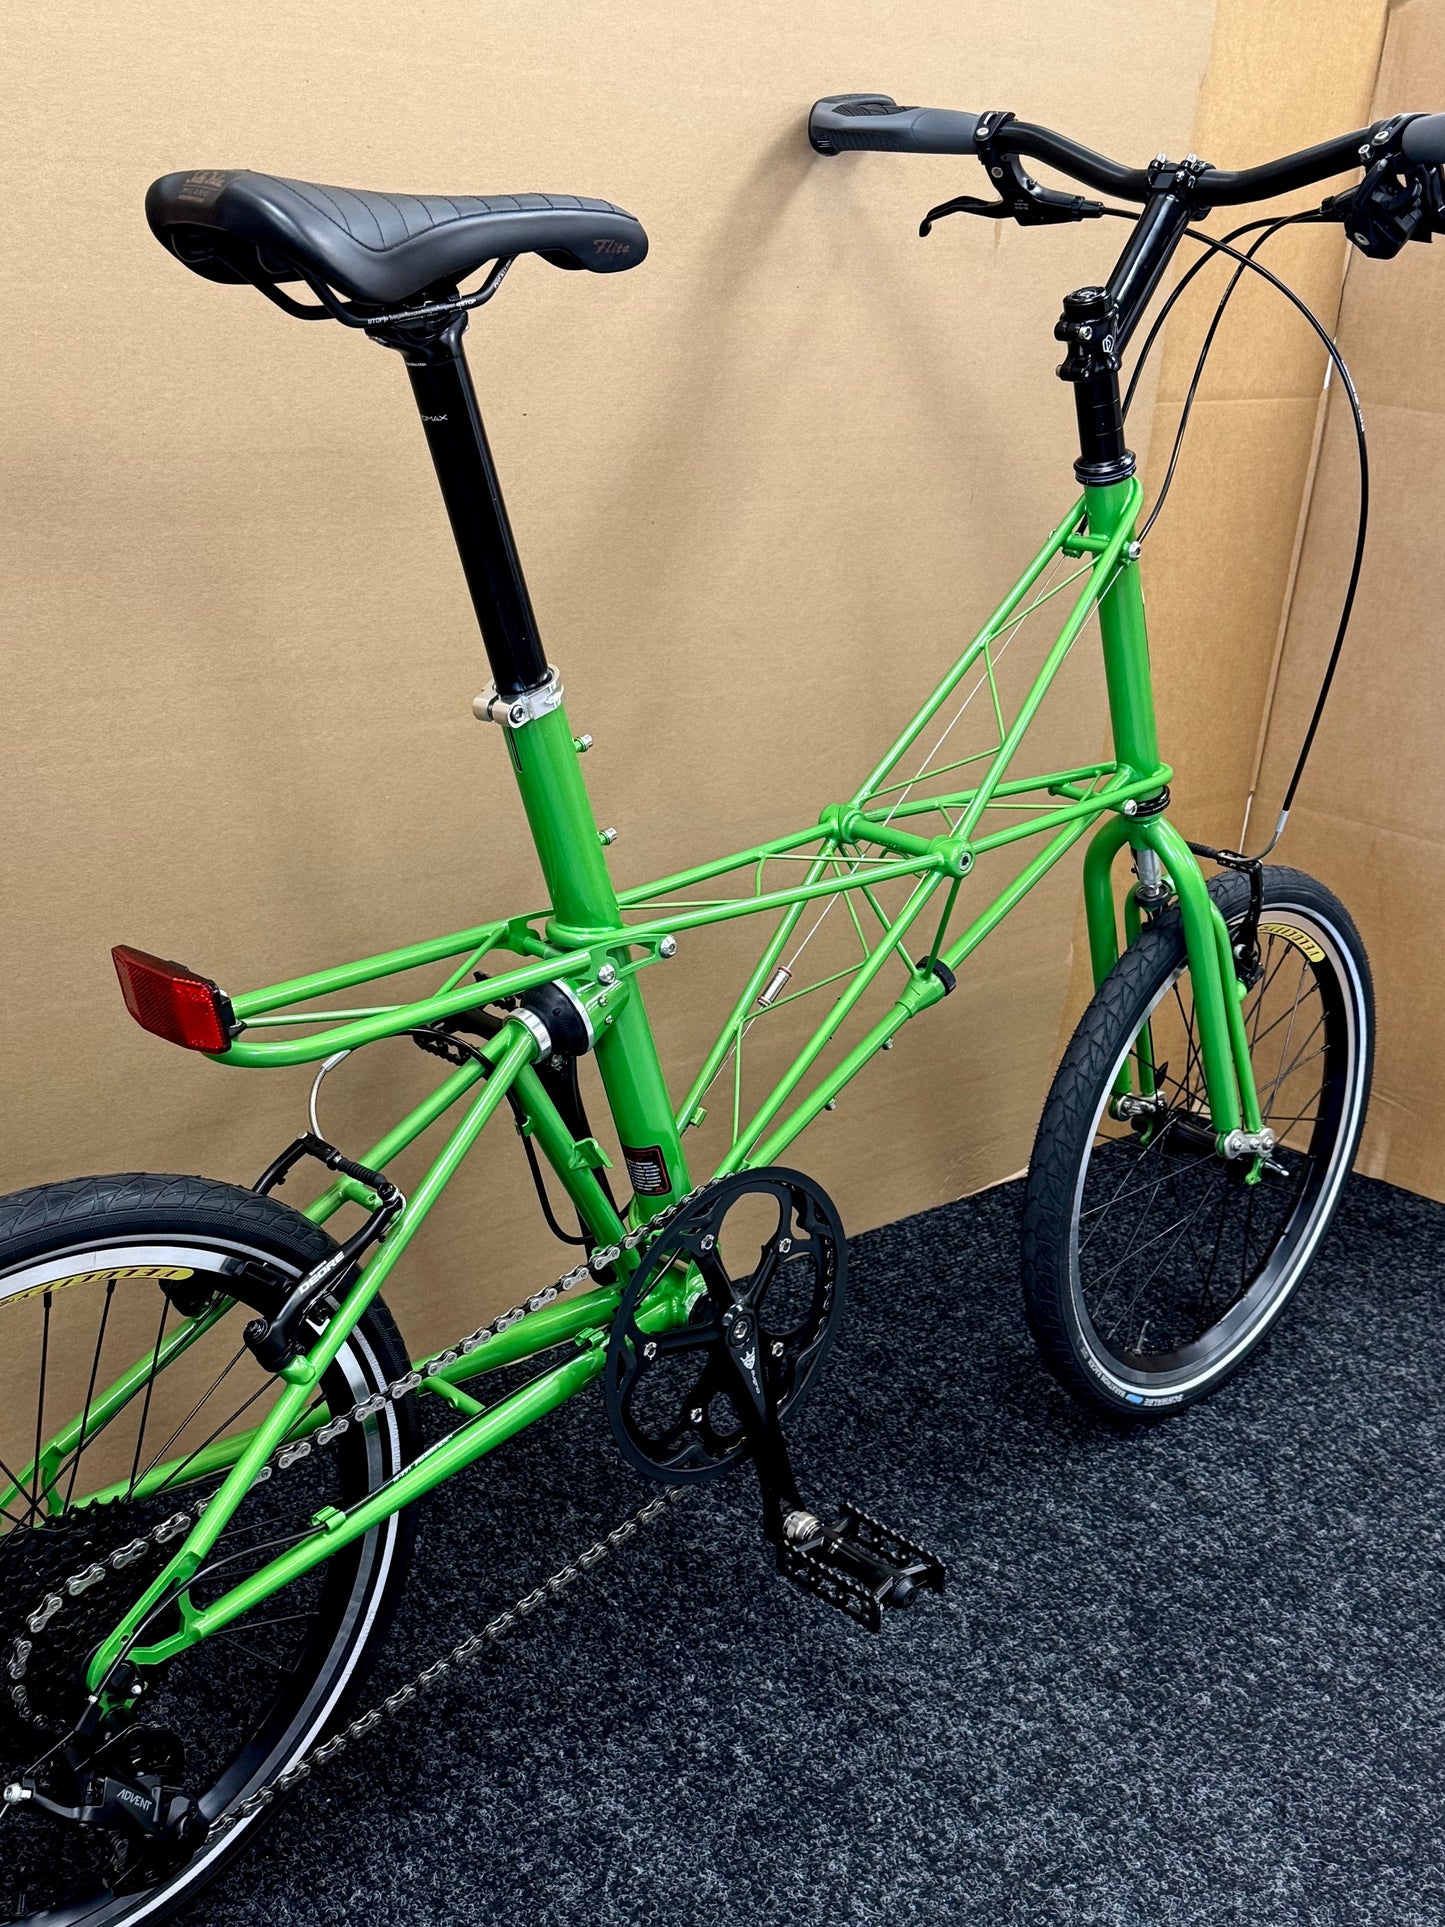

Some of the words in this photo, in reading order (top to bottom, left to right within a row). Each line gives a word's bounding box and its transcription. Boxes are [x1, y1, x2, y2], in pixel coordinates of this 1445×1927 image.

[299, 1250, 345, 1295] DEORE
[1143, 1393, 1184, 1407] SCHWALBE
[116, 1788, 153, 1811] ADVENT
